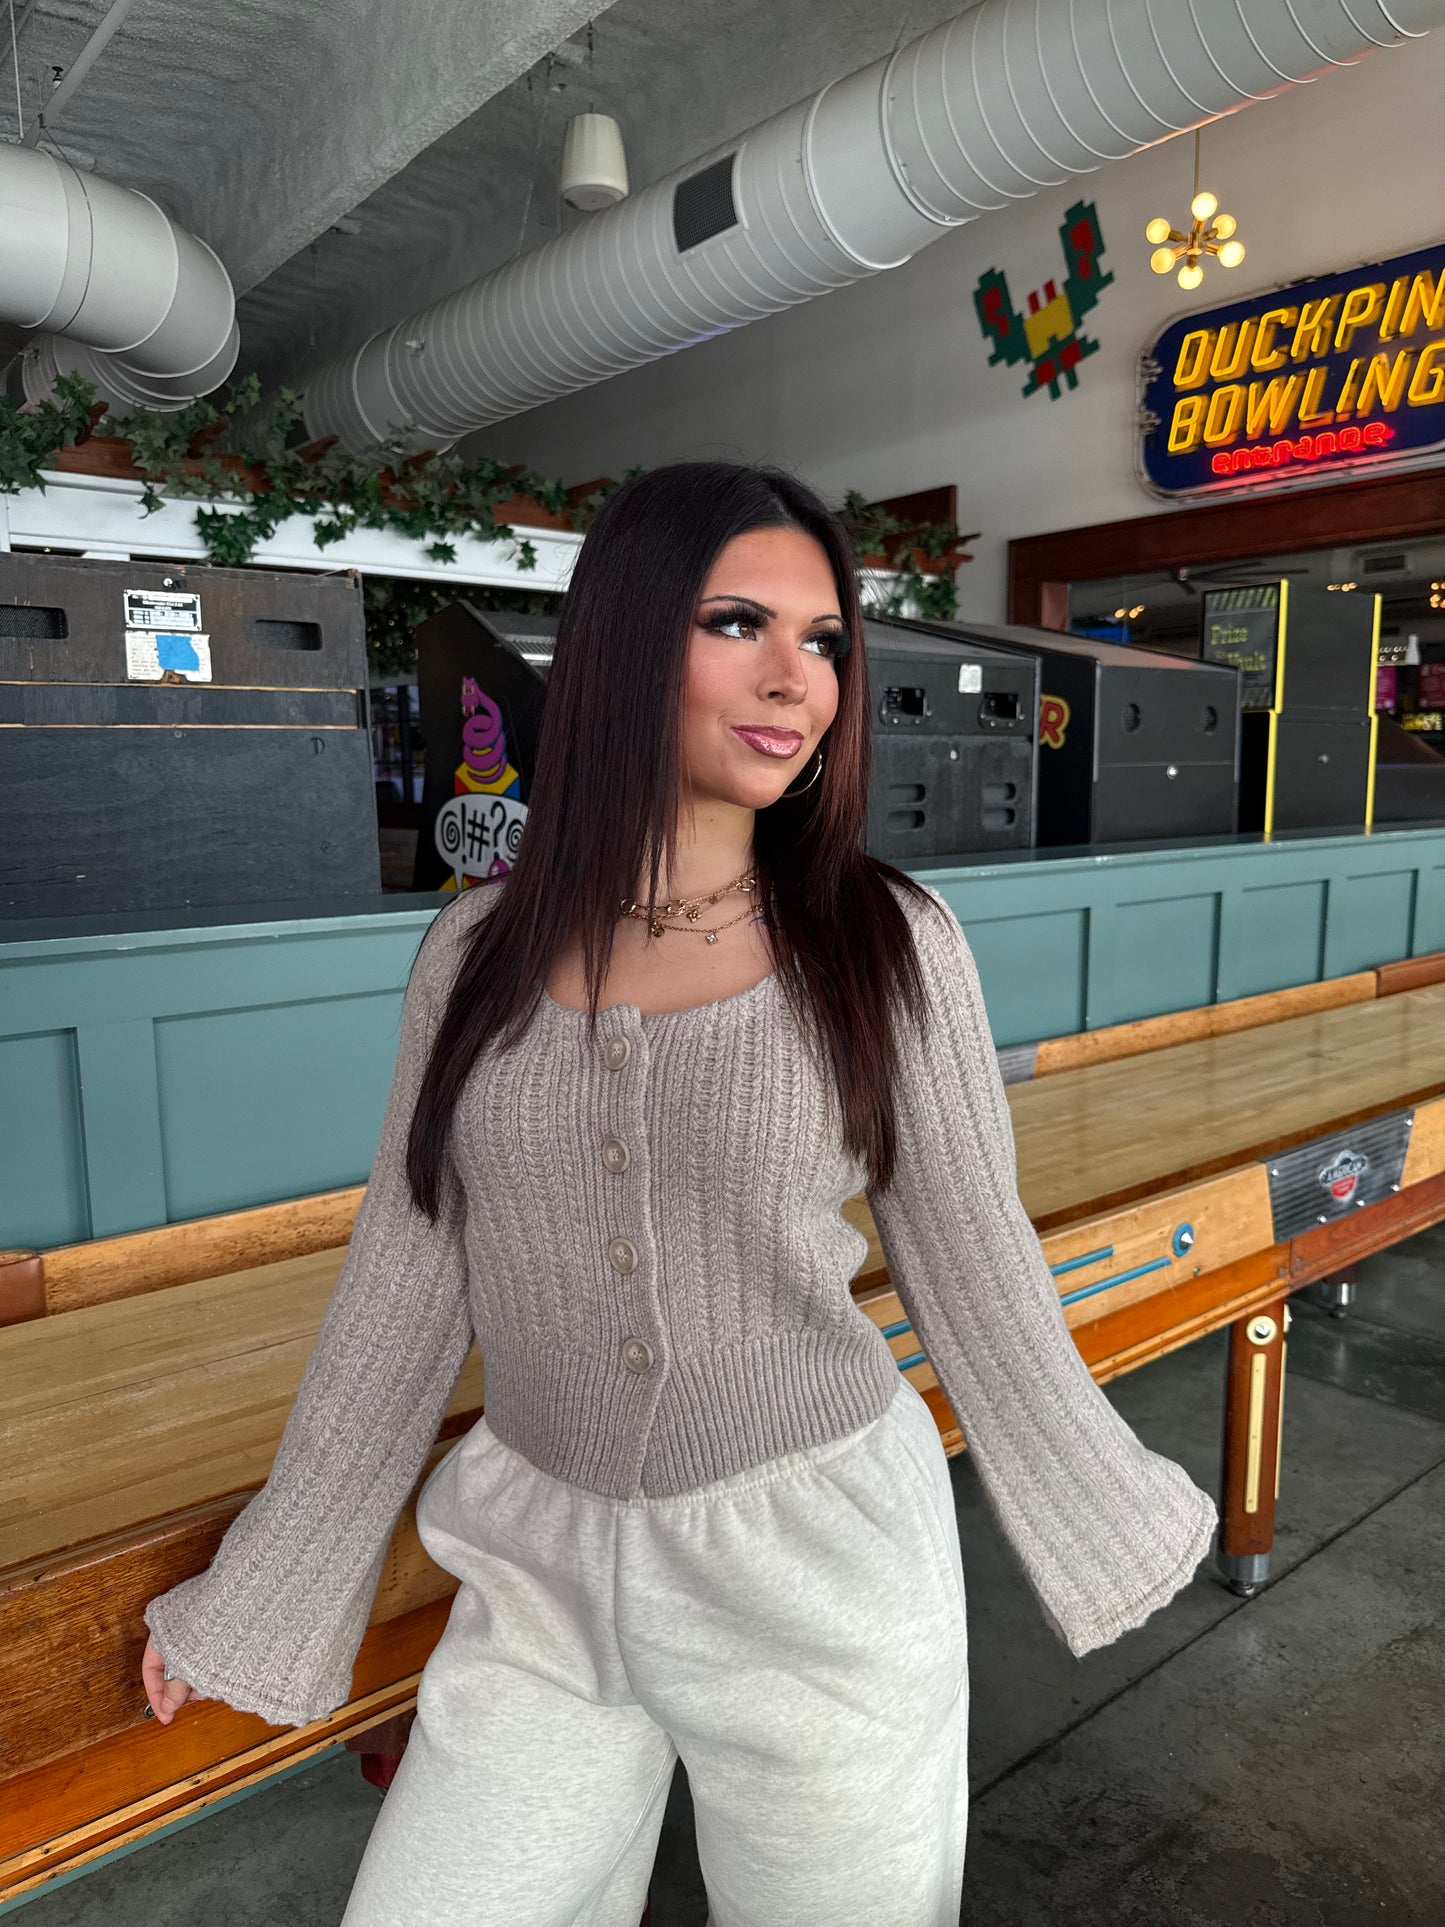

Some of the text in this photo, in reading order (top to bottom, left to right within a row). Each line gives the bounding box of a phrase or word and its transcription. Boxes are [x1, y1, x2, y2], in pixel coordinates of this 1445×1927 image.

[1173, 268, 1445, 389] DUCKPIN
[1167, 340, 1445, 455] BOWLING
[1211, 422, 1390, 474] entrance
